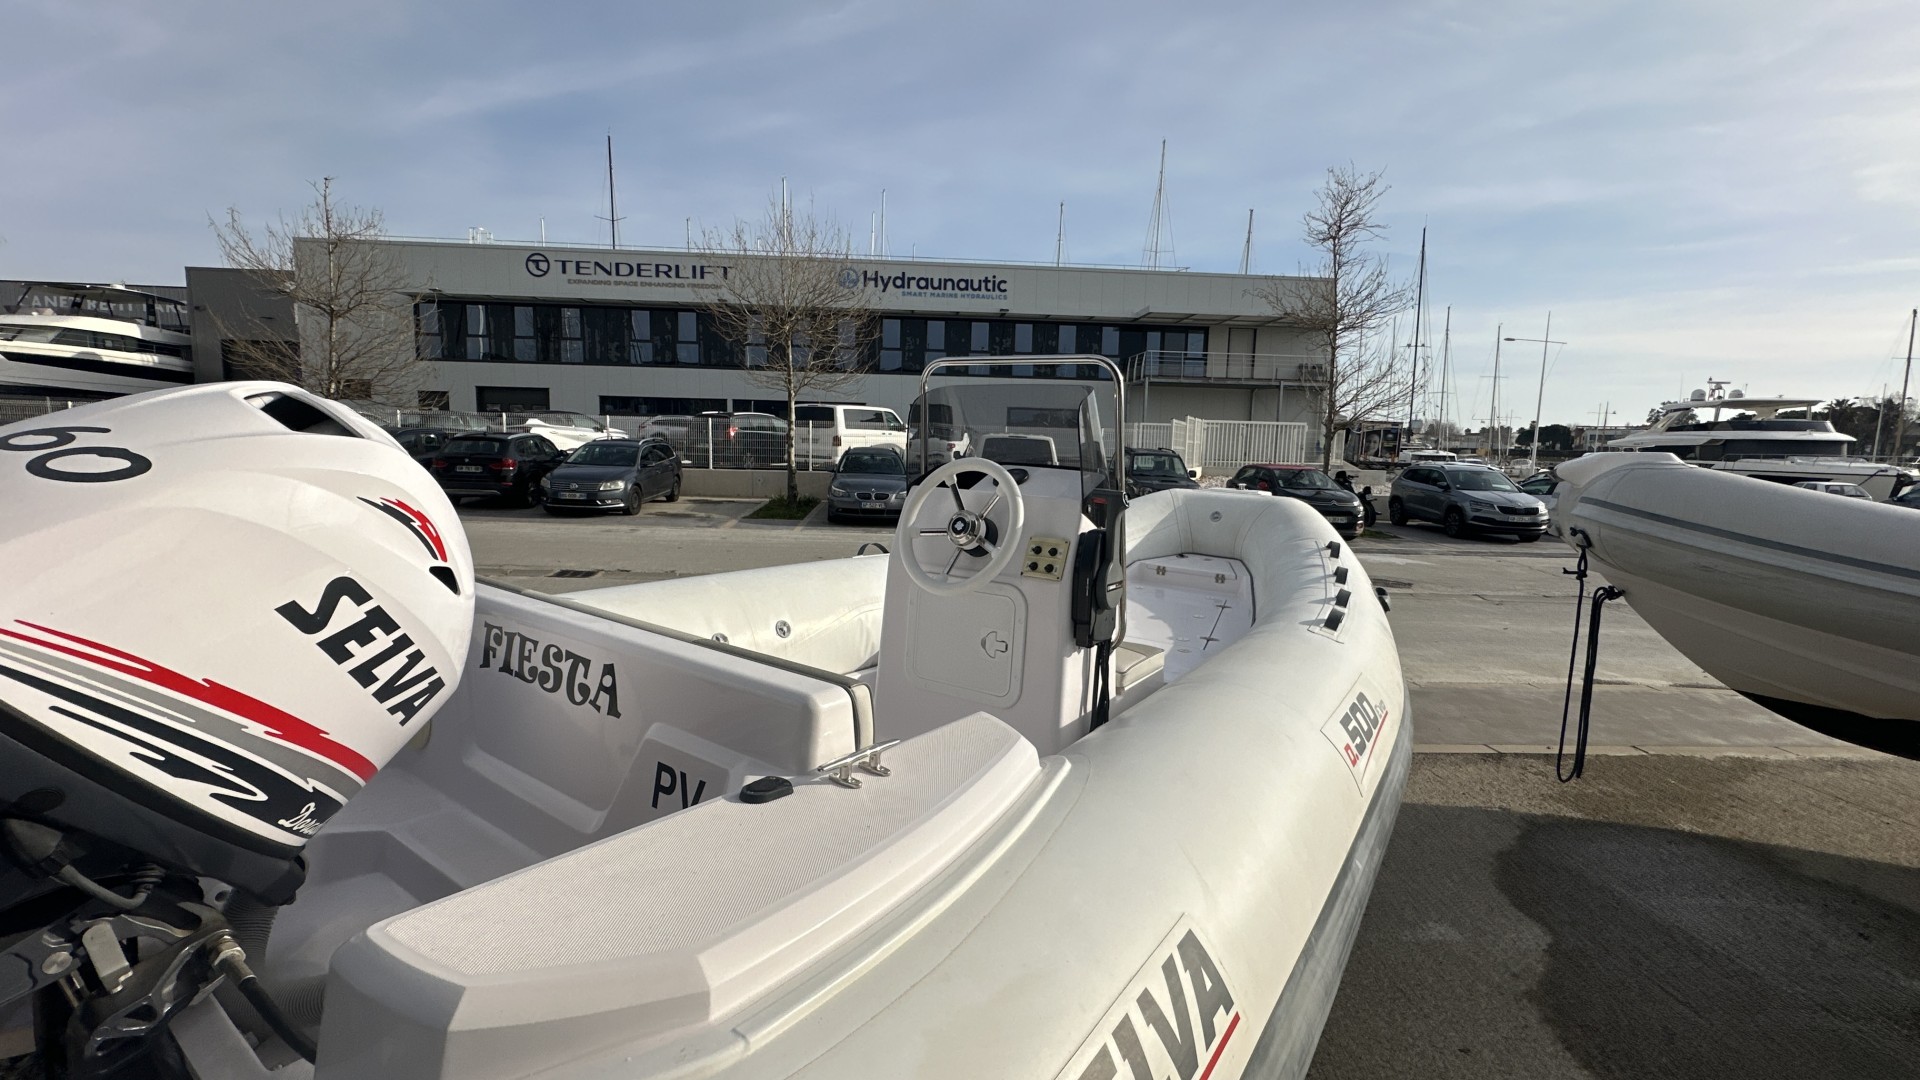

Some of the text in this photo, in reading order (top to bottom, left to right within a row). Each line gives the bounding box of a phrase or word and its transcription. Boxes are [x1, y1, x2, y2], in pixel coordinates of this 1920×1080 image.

[554, 259, 735, 280] TENDERLIFT
[567, 278, 612, 286] EXPANDING
[613, 279, 639, 288] SPACE
[640, 281, 686, 289] ENHANCING
[863, 270, 1008, 293] Hydraunautic
[0, 426, 153, 483] 60
[274, 576, 446, 727] SELVA
[479, 621, 622, 720] FIESTA
[651, 761, 706, 810] PV
